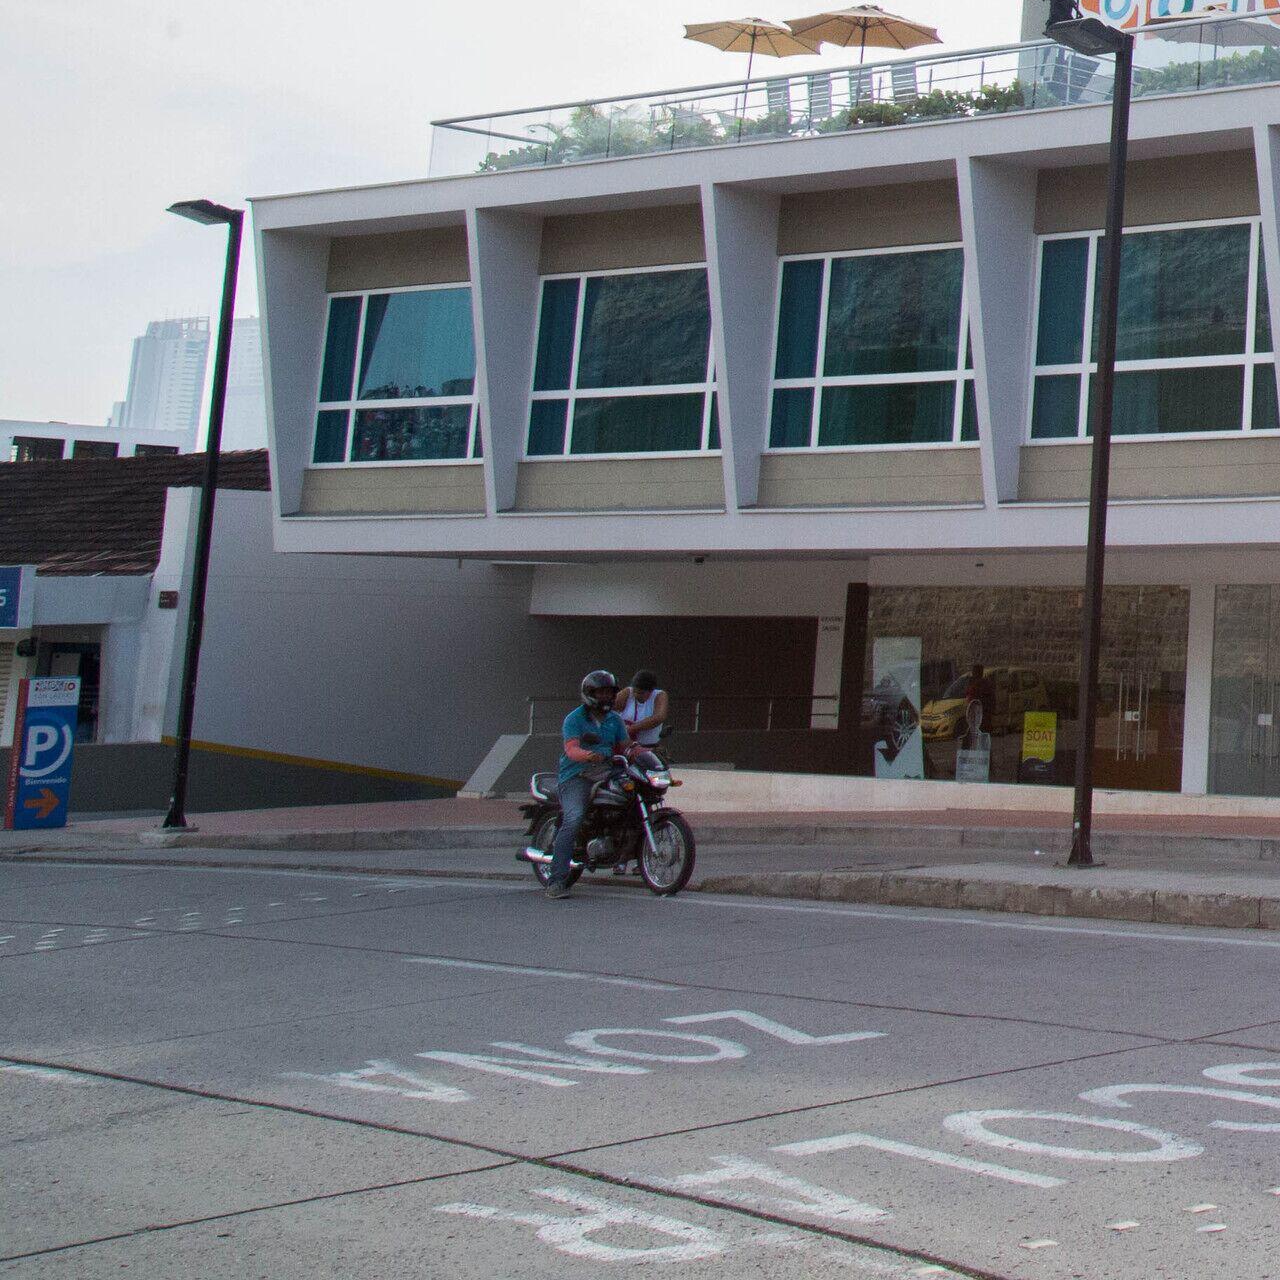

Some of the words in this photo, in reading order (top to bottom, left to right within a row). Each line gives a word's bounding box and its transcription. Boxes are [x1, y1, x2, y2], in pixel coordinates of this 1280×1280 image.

[24, 725, 59, 767] P
[1026, 729, 1053, 742] SOAT
[25, 776, 67, 786] Bienvenido
[281, 1009, 889, 1104] ZONA
